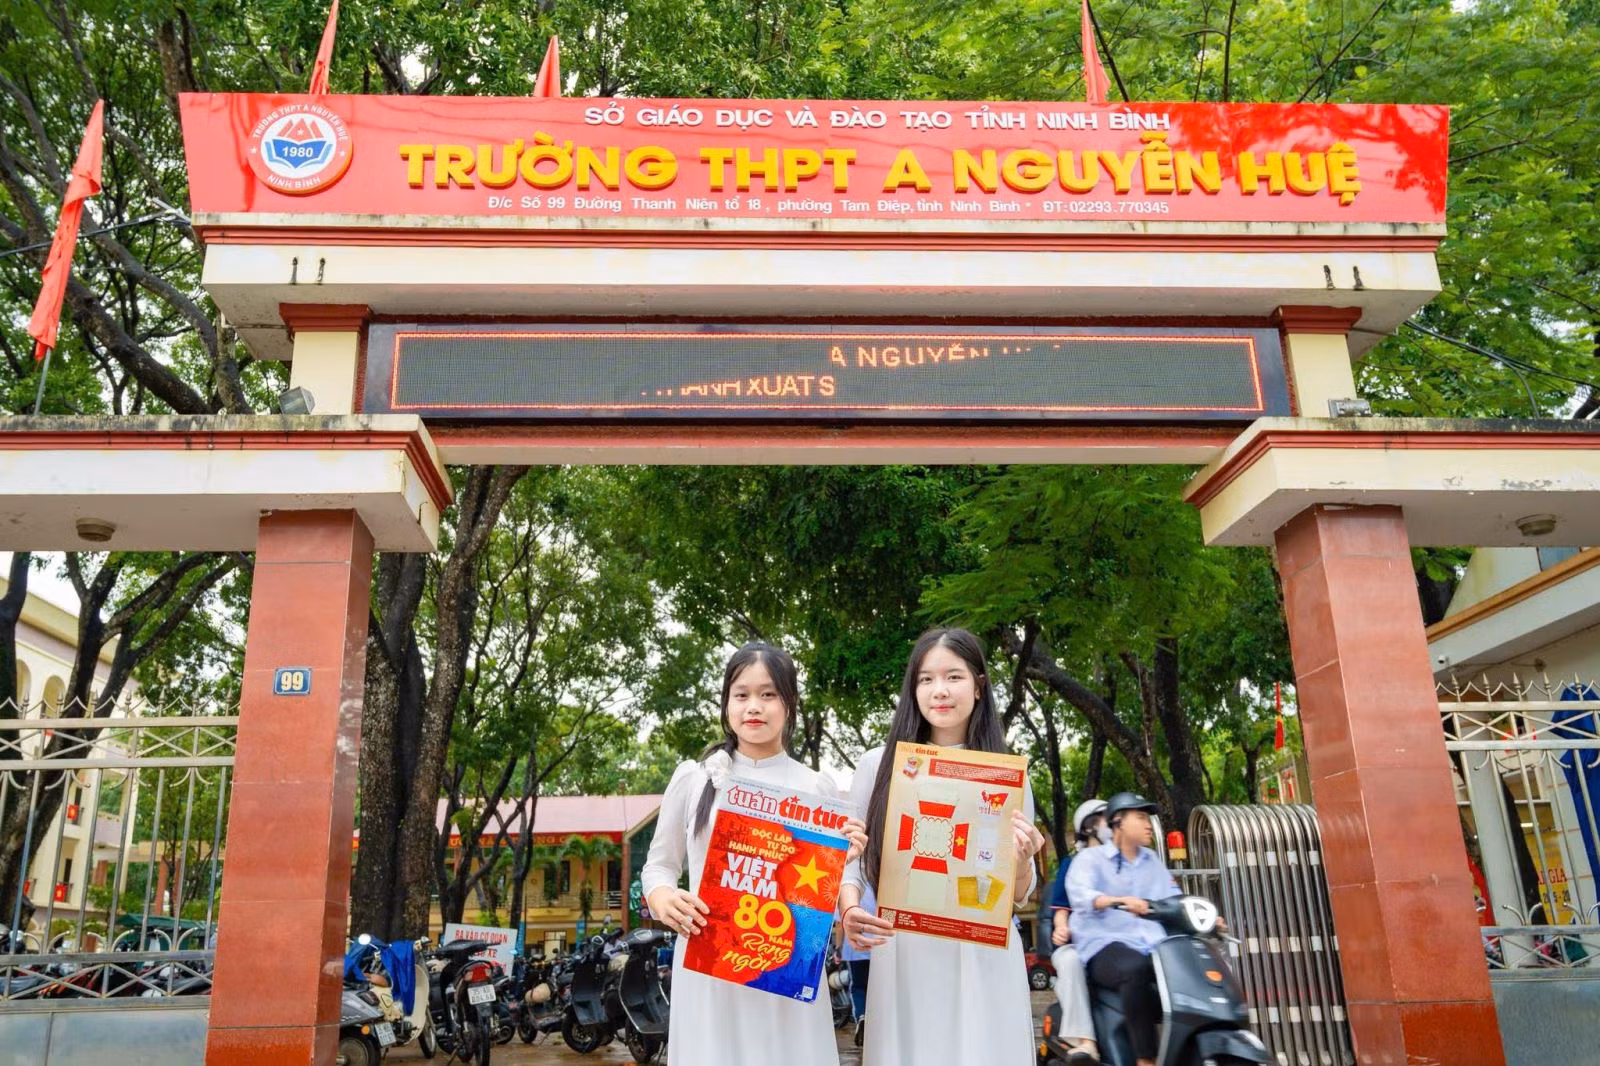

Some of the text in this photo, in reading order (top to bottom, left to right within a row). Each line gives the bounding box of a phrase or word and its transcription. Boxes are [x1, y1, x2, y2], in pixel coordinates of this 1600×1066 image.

[303, 103, 310, 112] A
[584, 101, 1171, 132] SỞ GIÁO DỤC VÀ ĐÀO TẠO TỈNH NINH BÌNH
[282, 146, 314, 158] 1980
[399, 130, 1361, 206] TRƯỜNG THPT A NGUYỄN HUỆ
[488, 196, 513, 209] Đ/c
[521, 194, 542, 209] Số
[547, 197, 566, 209] 99
[573, 195, 622, 212] Đường
[632, 197, 676, 210] Thanh
[686, 197, 718, 210] Niên
[778, 198, 832, 214] phường
[839, 199, 870, 212] Tam
[950, 200, 982, 212] Ninh
[831, 346, 847, 367] A
[819, 375, 835, 396] S
[281, 671, 303, 690] 99
[778, 795, 811, 823] tin
[733, 894, 792, 936] 80
